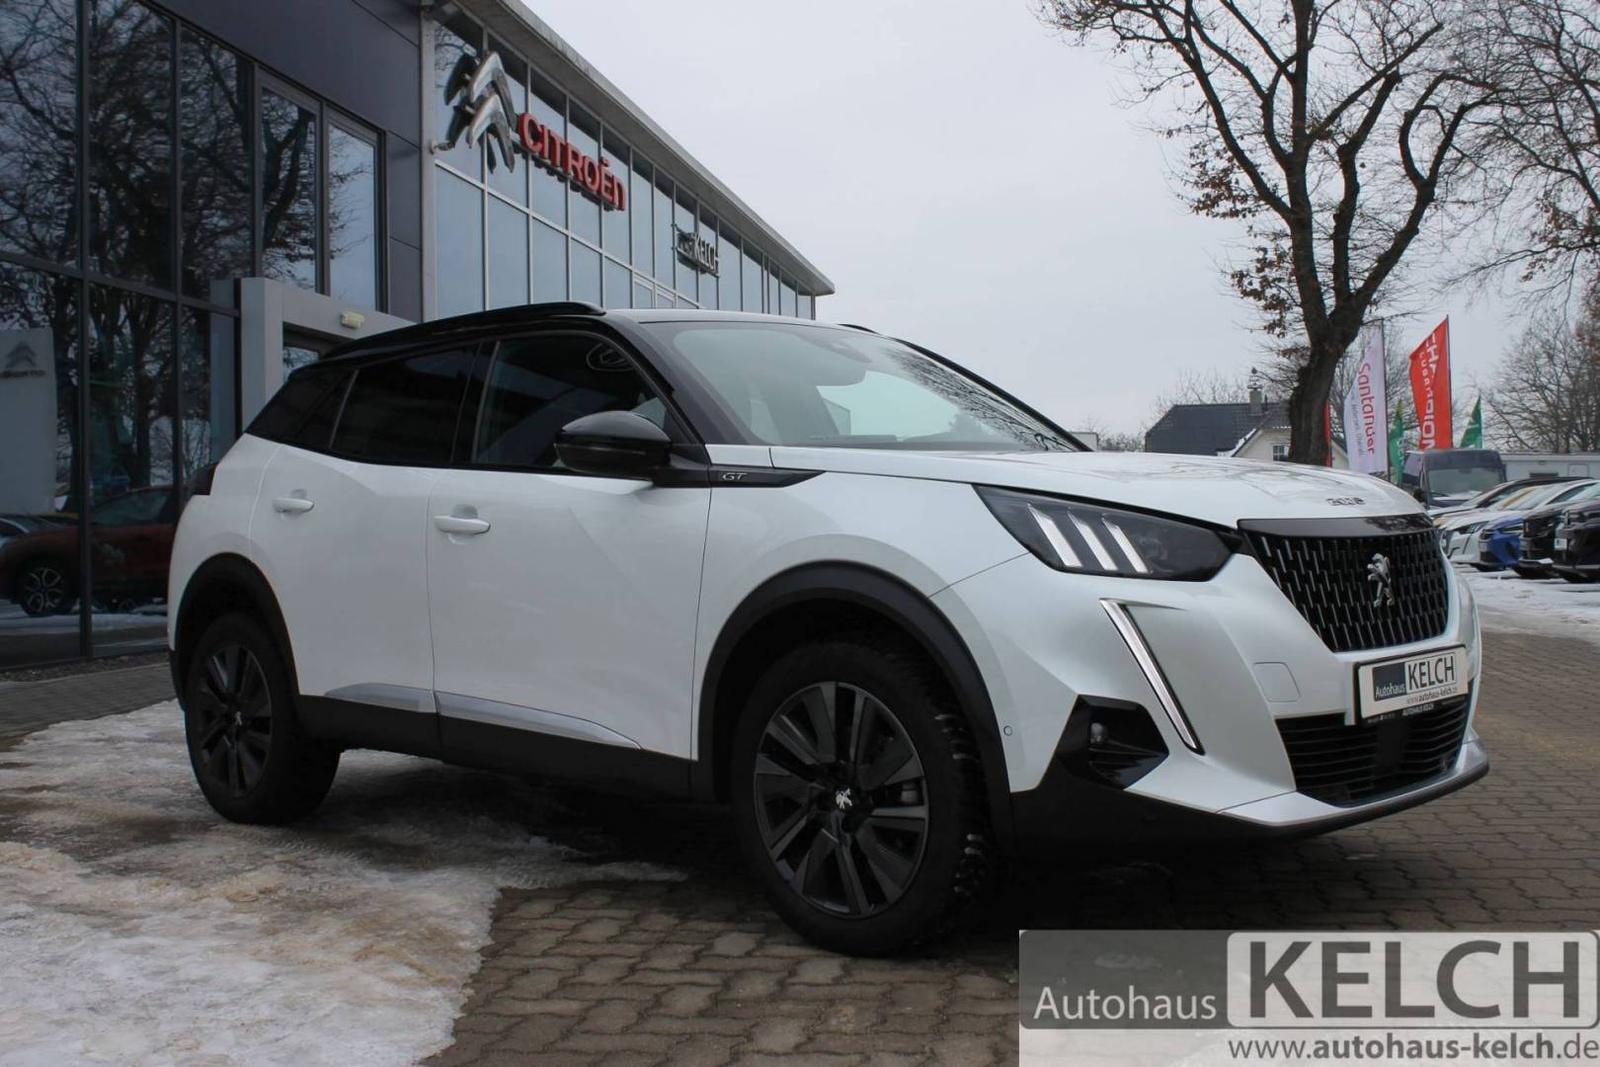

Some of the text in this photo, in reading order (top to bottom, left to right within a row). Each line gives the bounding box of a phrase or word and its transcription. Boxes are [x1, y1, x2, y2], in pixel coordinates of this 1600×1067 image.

[519, 112, 627, 211] CITROËN
[1358, 363, 1376, 455] Santander
[721, 472, 748, 481] GT
[1375, 655, 1455, 698] Autohaus KELCH
